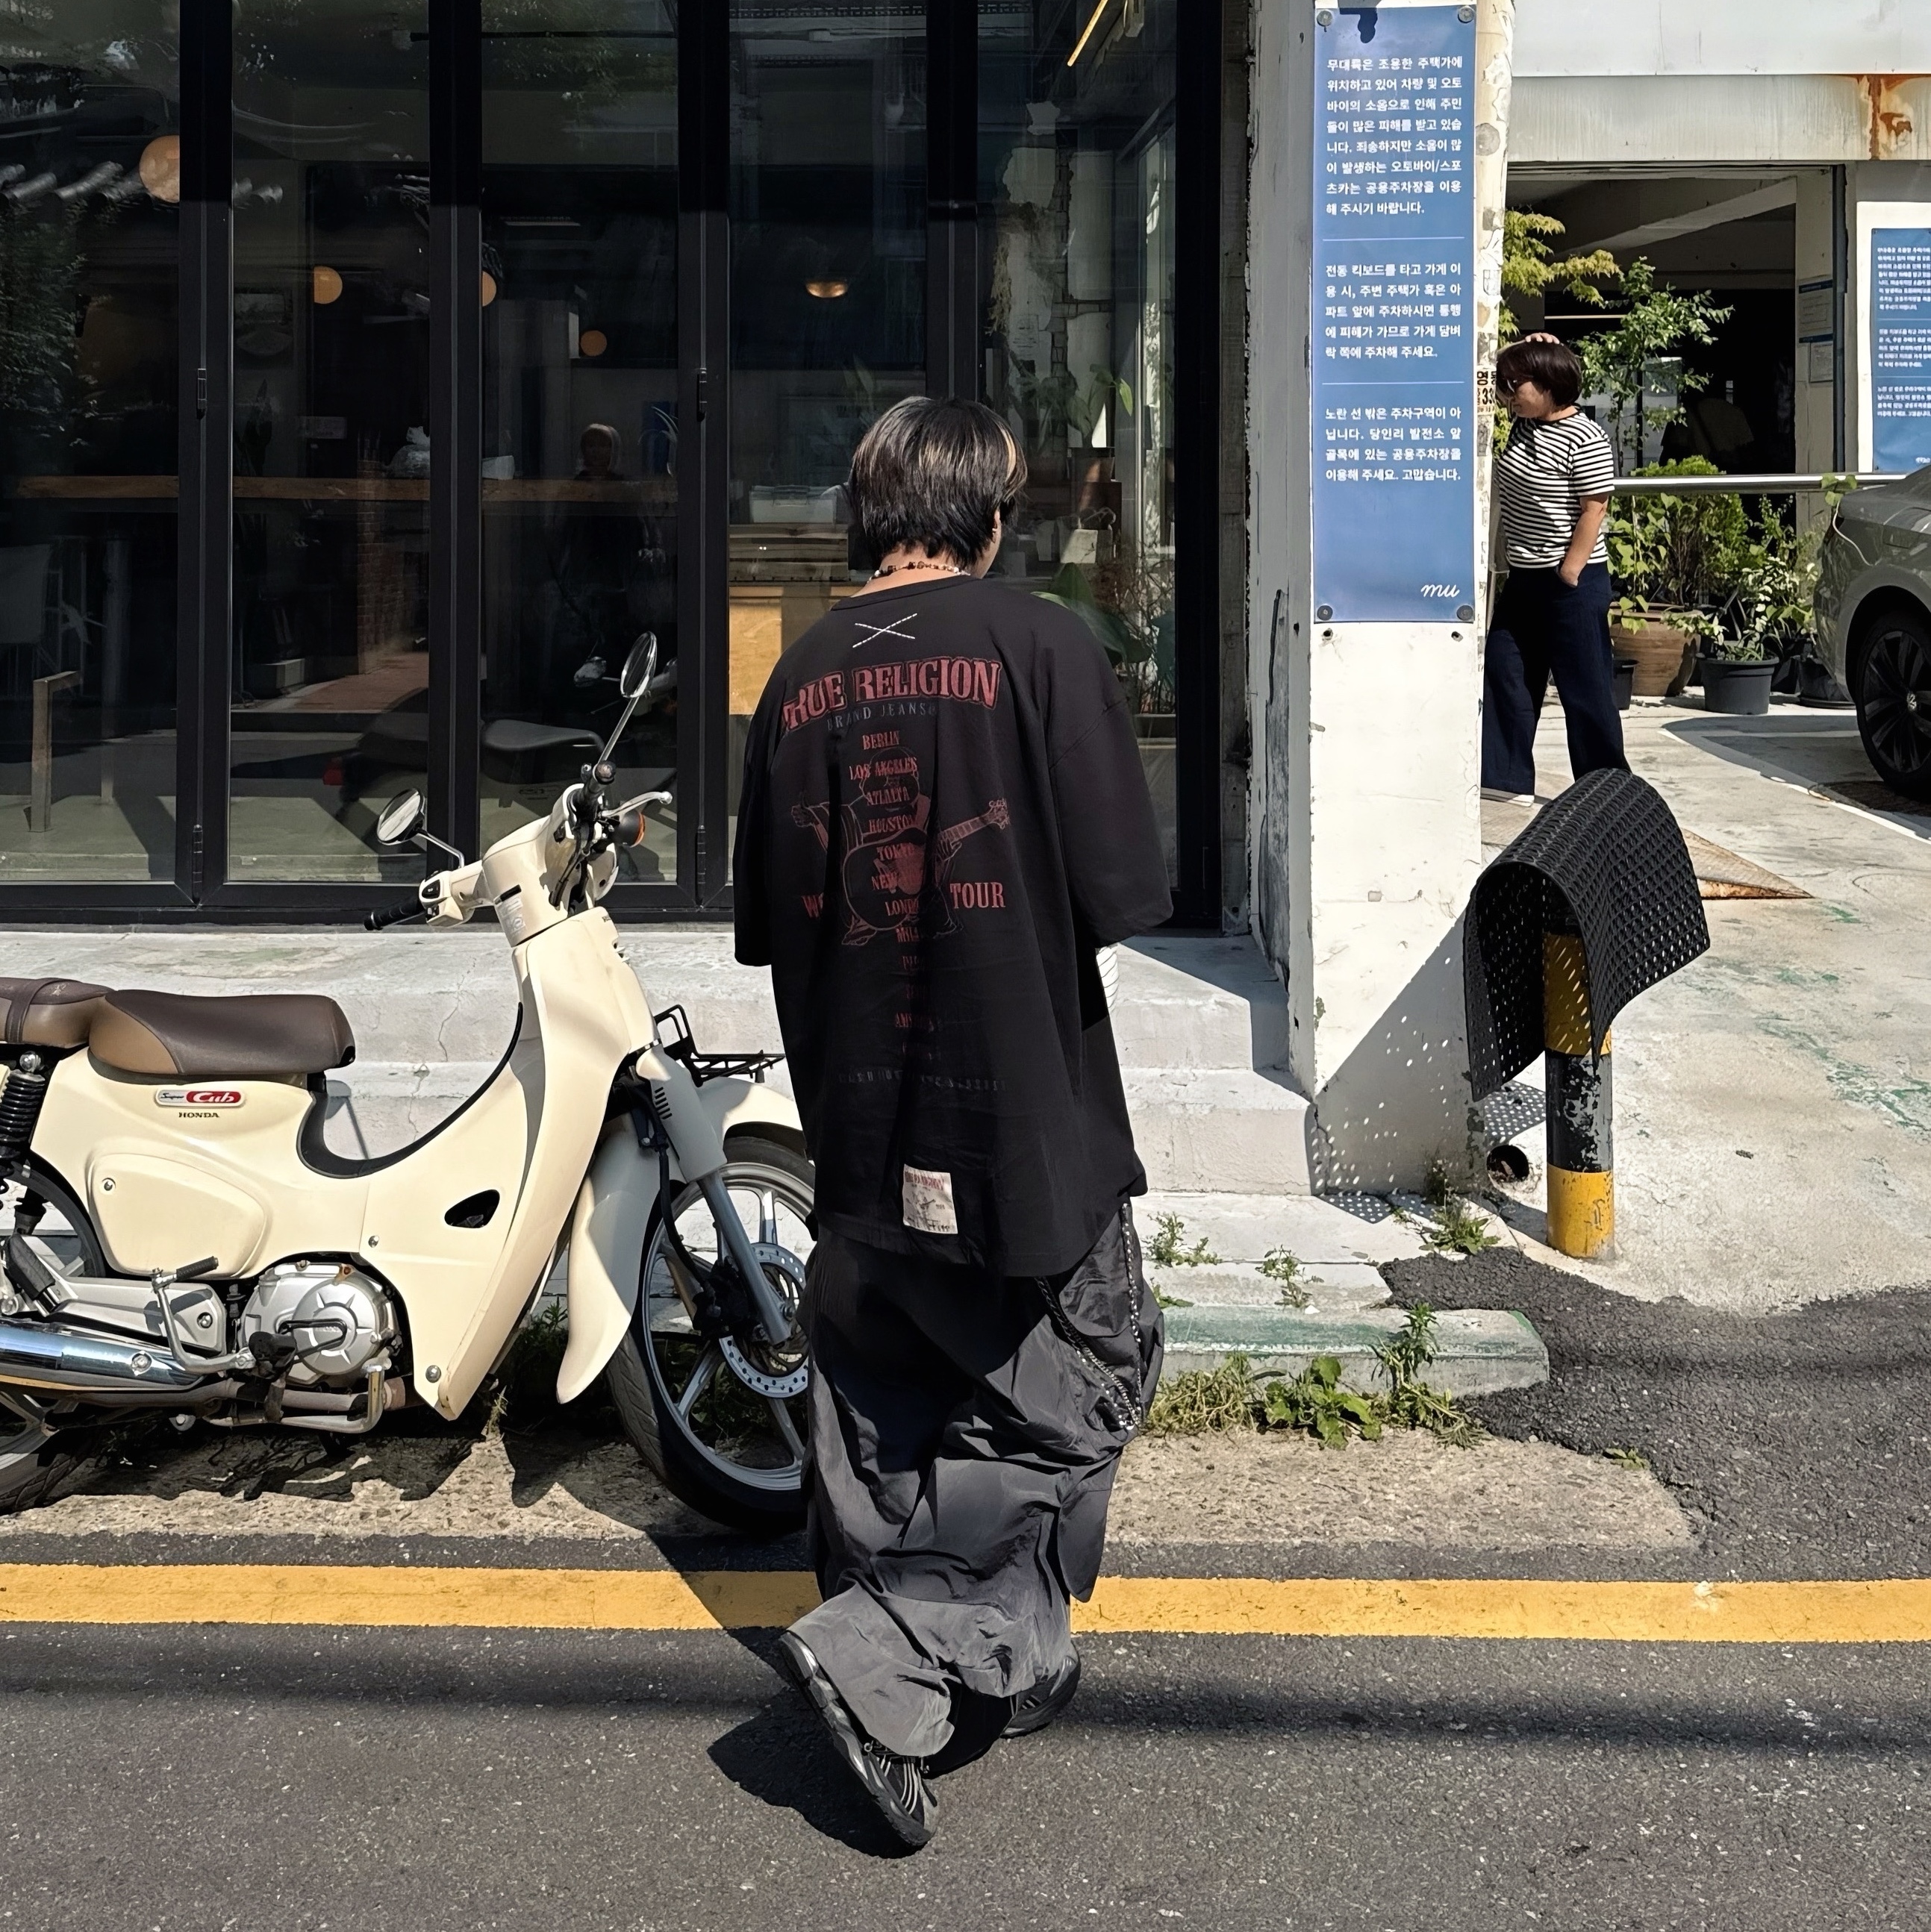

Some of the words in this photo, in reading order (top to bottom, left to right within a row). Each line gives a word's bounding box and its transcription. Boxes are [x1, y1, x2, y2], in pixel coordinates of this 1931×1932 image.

[1379, 58, 1412, 70] 조용한
[1418, 56, 1462, 69] 주택가에
[1328, 79, 1371, 92] 위치하고
[1375, 78, 1397, 90] 있어
[1401, 78, 1423, 90] 차량
[1441, 78, 1461, 88] 오토
[1327, 100, 1360, 113] 바이의
[1365, 99, 1409, 111] 소음으로
[1414, 99, 1435, 110] 인해
[1441, 98, 1461, 110] 주민
[1379, 119, 1411, 132] 피해를
[1416, 119, 1436, 131] 받고
[1441, 119, 1461, 131] 있습
[1327, 142, 1352, 154] 니다.
[1415, 140, 1447, 151] 소음이
[1451, 139, 1461, 151] 많
[1326, 162, 1337, 174] 이
[1342, 161, 1386, 174] 발생하는
[1391, 160, 1461, 172] 오토바이/스포
[1326, 183, 1360, 195] 츠카는
[1440, 181, 1461, 193] 이용
[1326, 204, 1337, 215] 해
[1341, 203, 1373, 215] 주시기
[1377, 201, 1424, 214] 바랍니다.
[1326, 265, 1347, 277] 전동
[1400, 264, 1421, 276] 타고
[1425, 263, 1446, 275] 가게
[1450, 263, 1460, 275] 이
[1326, 286, 1336, 298] 용
[1341, 285, 1356, 298] 시,
[1360, 285, 1382, 297] 주변
[1387, 284, 1420, 297] 주택가
[1450, 284, 1461, 296] 아
[1326, 307, 1347, 318] 파트
[1353, 306, 1374, 317] 앞에
[1379, 304, 1434, 317] 주차하시면
[1341, 326, 1373, 338] 피해가
[1377, 326, 1409, 338] 가므로
[1414, 325, 1435, 337] 가게
[1440, 325, 1460, 337] 담벼
[1365, 346, 1397, 358] 주차해
[1401, 346, 1437, 358] 주세요.
[1326, 408, 1347, 420] 노란
[1351, 407, 1361, 419] 선
[1391, 407, 1445, 419] 주차구역이
[1450, 407, 1461, 419] 아
[1326, 428, 1364, 440] 닙니다.
[1410, 428, 1444, 440] 발전소
[1450, 428, 1461, 440] 앞
[1364, 448, 1387, 460] 있는
[1362, 469, 1398, 481] 주세요.
[1403, 469, 1460, 481] 고맙습니다.
[1421, 584, 1459, 597] mu
[852, 657, 1001, 709] RELIGION
[862, 730, 900, 751] BERLIN
[849, 763, 870, 781] LOS
[950, 881, 1005, 910] TOUR
[193, 1092, 234, 1103] Cub
